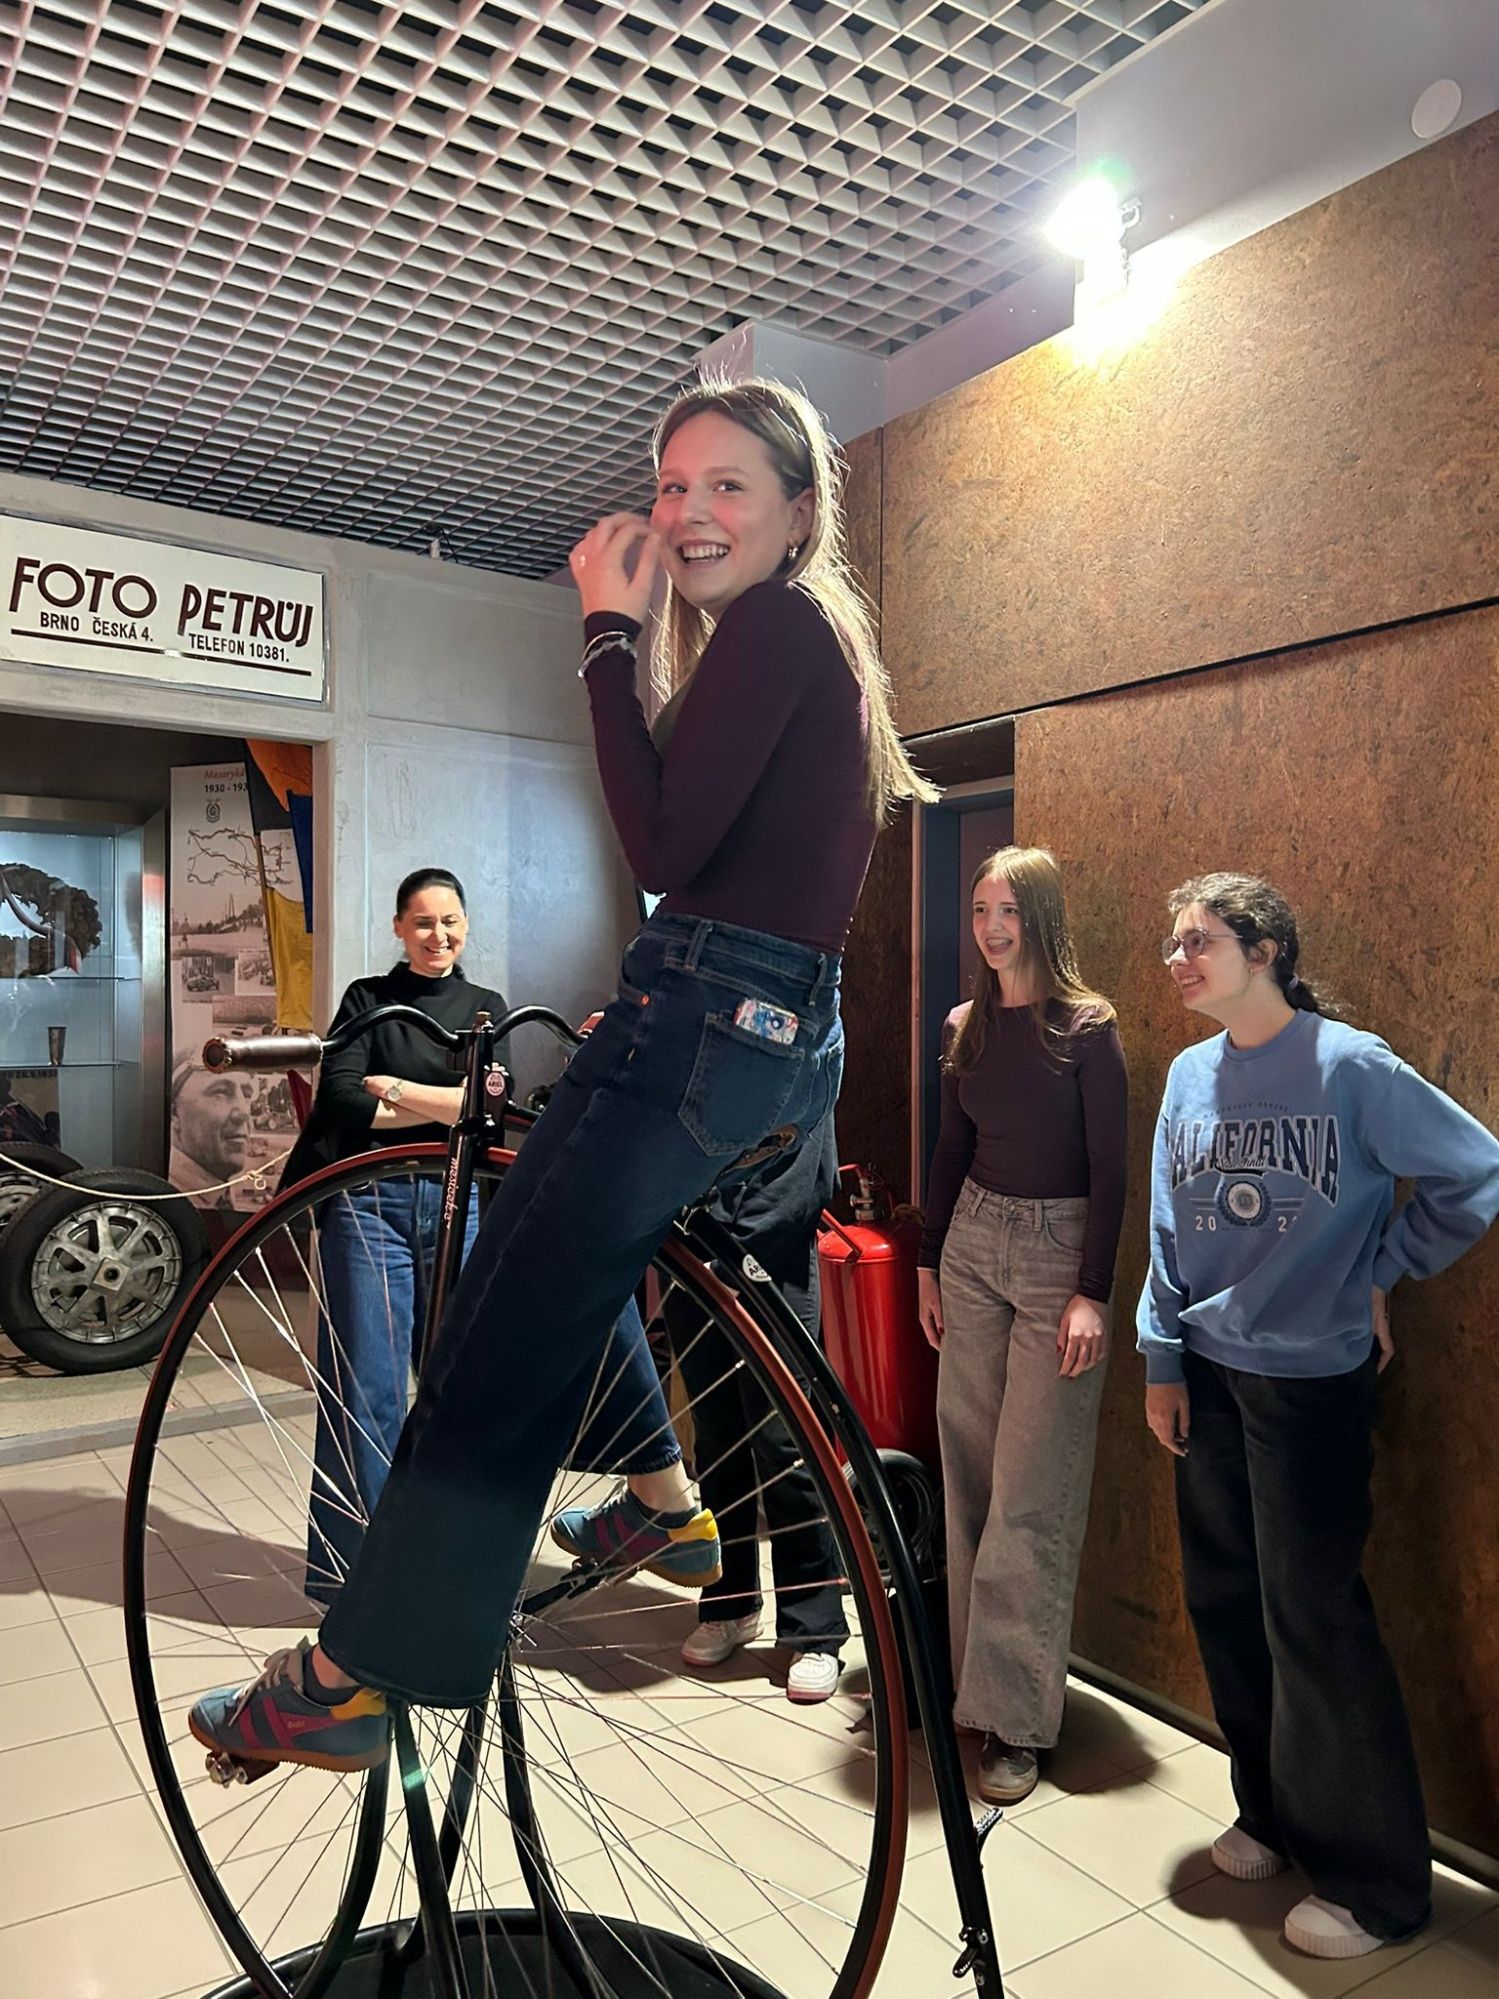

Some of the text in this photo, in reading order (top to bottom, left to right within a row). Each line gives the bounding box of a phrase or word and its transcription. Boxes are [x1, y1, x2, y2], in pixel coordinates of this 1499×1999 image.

[9, 557, 313, 648] FOTO PETRŮJ
[40, 611, 154, 642] BRNO ČESKÁ 4.
[189, 634, 290, 663] TELEFON 10381.
[205, 783, 225, 793] 1930
[233, 782, 249, 792] 193
[1171, 1114, 1341, 1208] ALIFORNIA
[1195, 1215, 1298, 1233] 20 2
